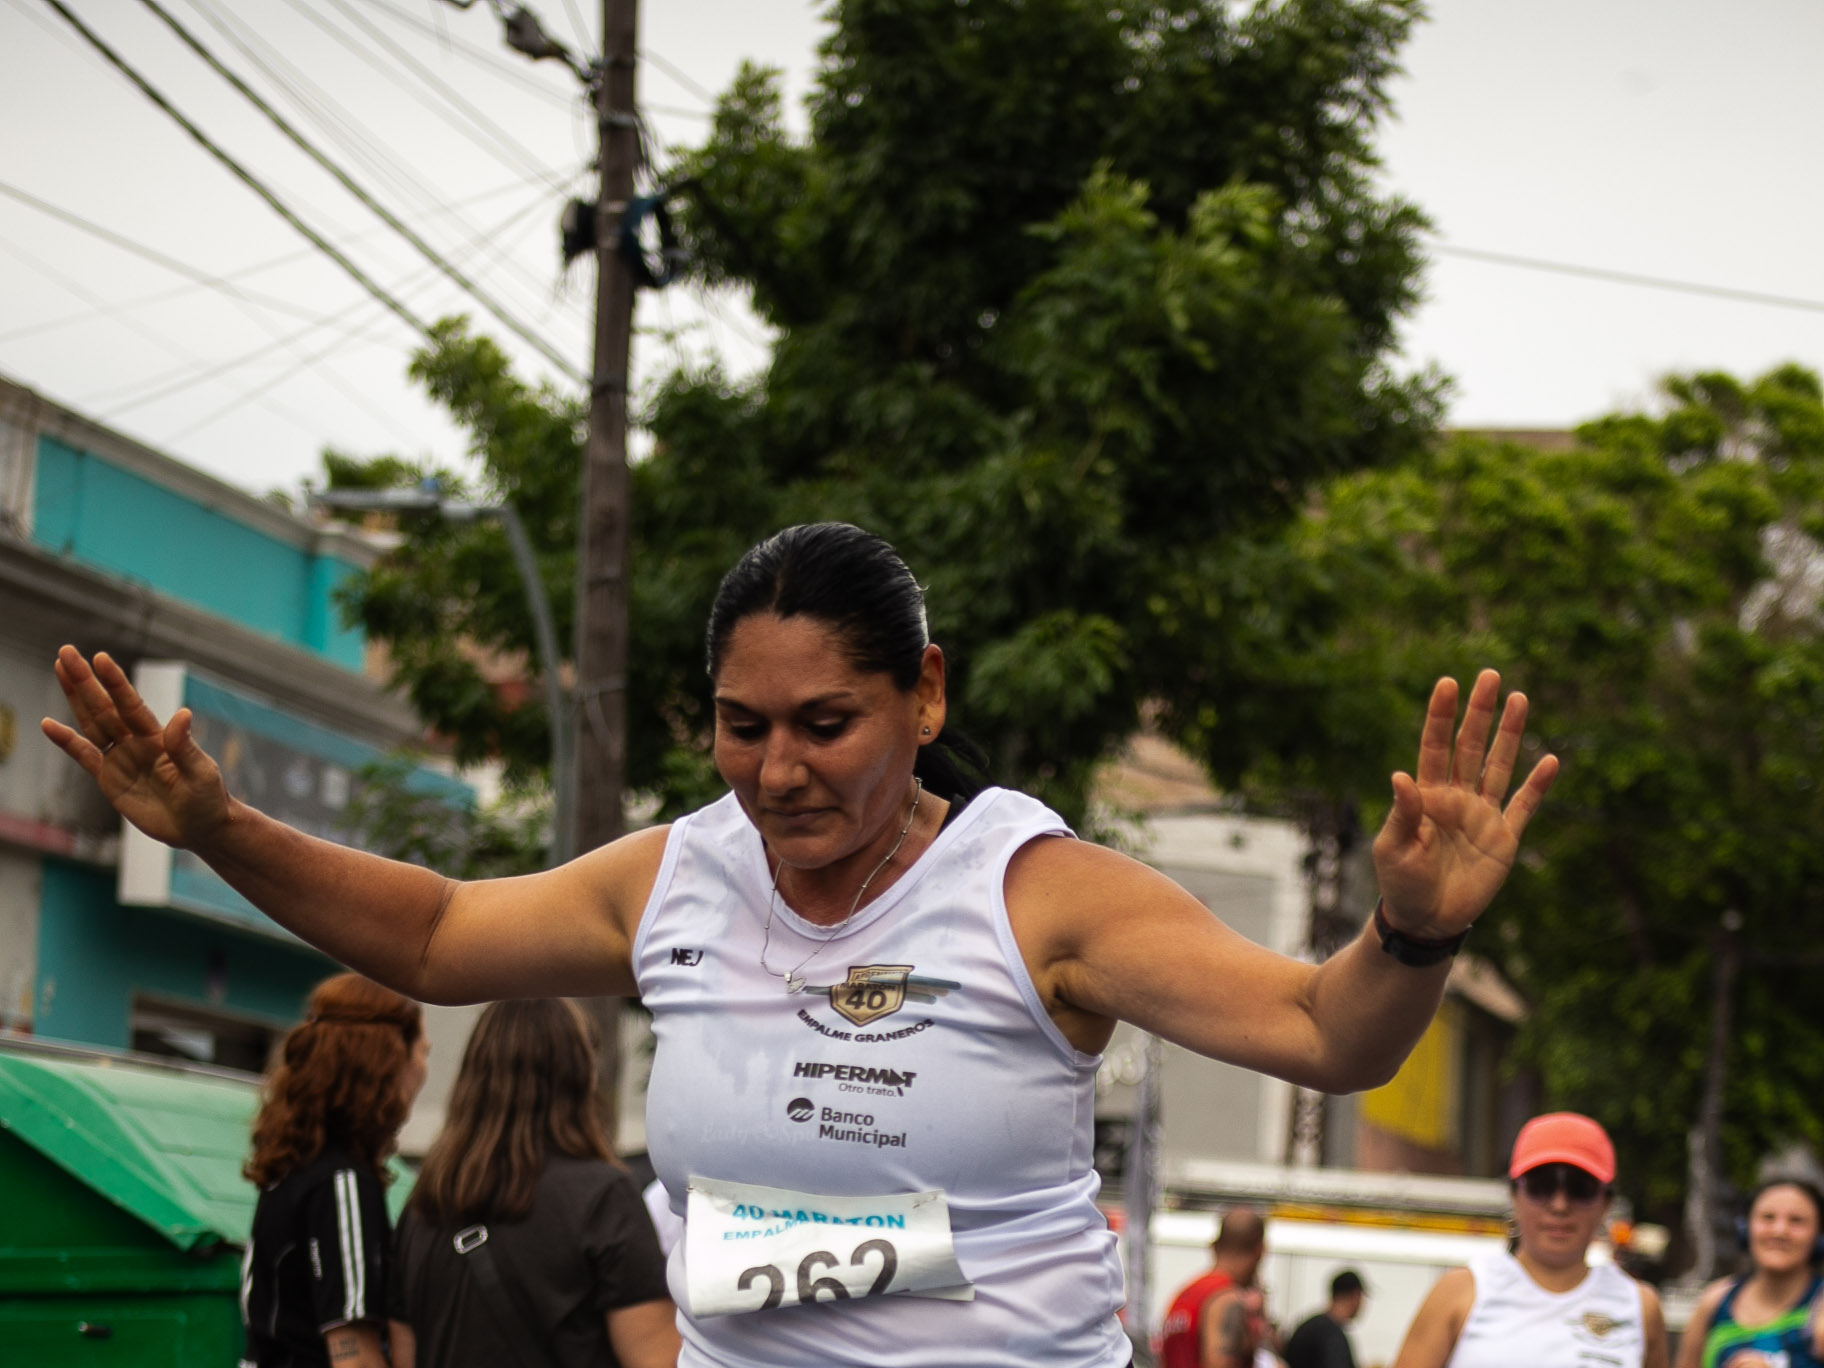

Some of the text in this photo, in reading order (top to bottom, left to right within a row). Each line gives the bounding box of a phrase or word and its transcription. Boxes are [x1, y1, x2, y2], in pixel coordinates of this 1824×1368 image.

[845, 989, 887, 1010] 40
[797, 1009, 934, 1042] EMPALME GRANEROS
[838, 1083, 865, 1094] Otro
[821, 1107, 875, 1126] Banco
[819, 1124, 907, 1149] Municipal
[732, 1204, 765, 1220] 40
[737, 1239, 898, 1311] 262
